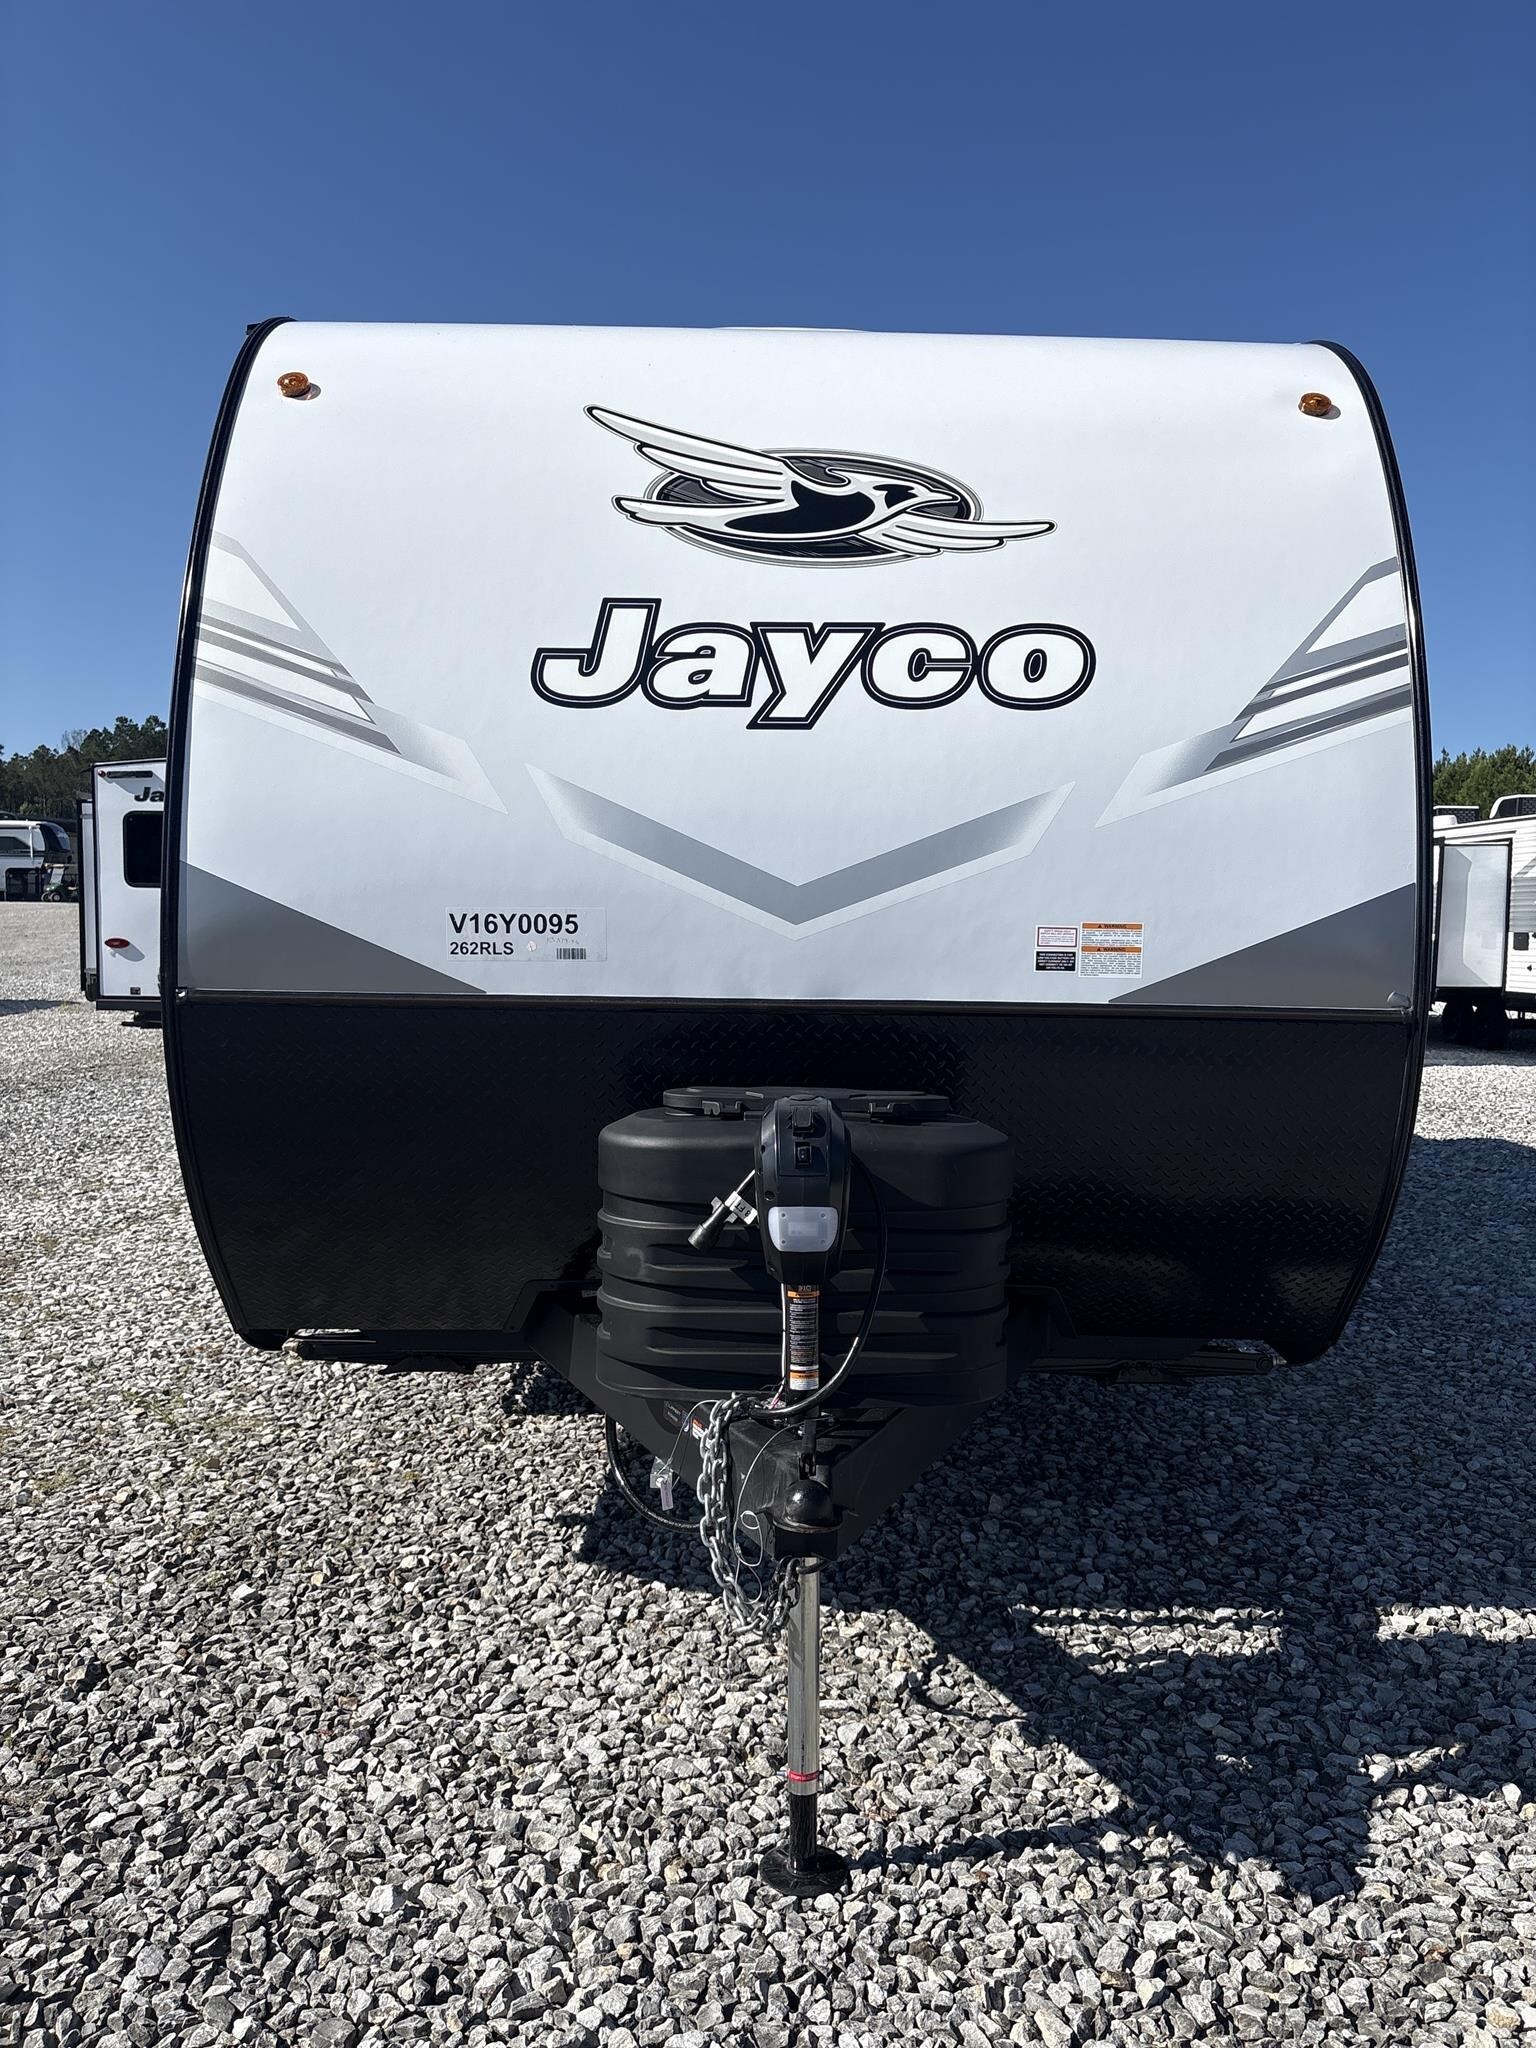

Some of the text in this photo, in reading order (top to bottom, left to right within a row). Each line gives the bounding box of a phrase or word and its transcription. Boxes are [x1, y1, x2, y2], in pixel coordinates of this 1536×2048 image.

[530, 597, 1097, 730] Jayco
[449, 913, 579, 935] V16Y0095
[449, 941, 514, 955] 262RLS
